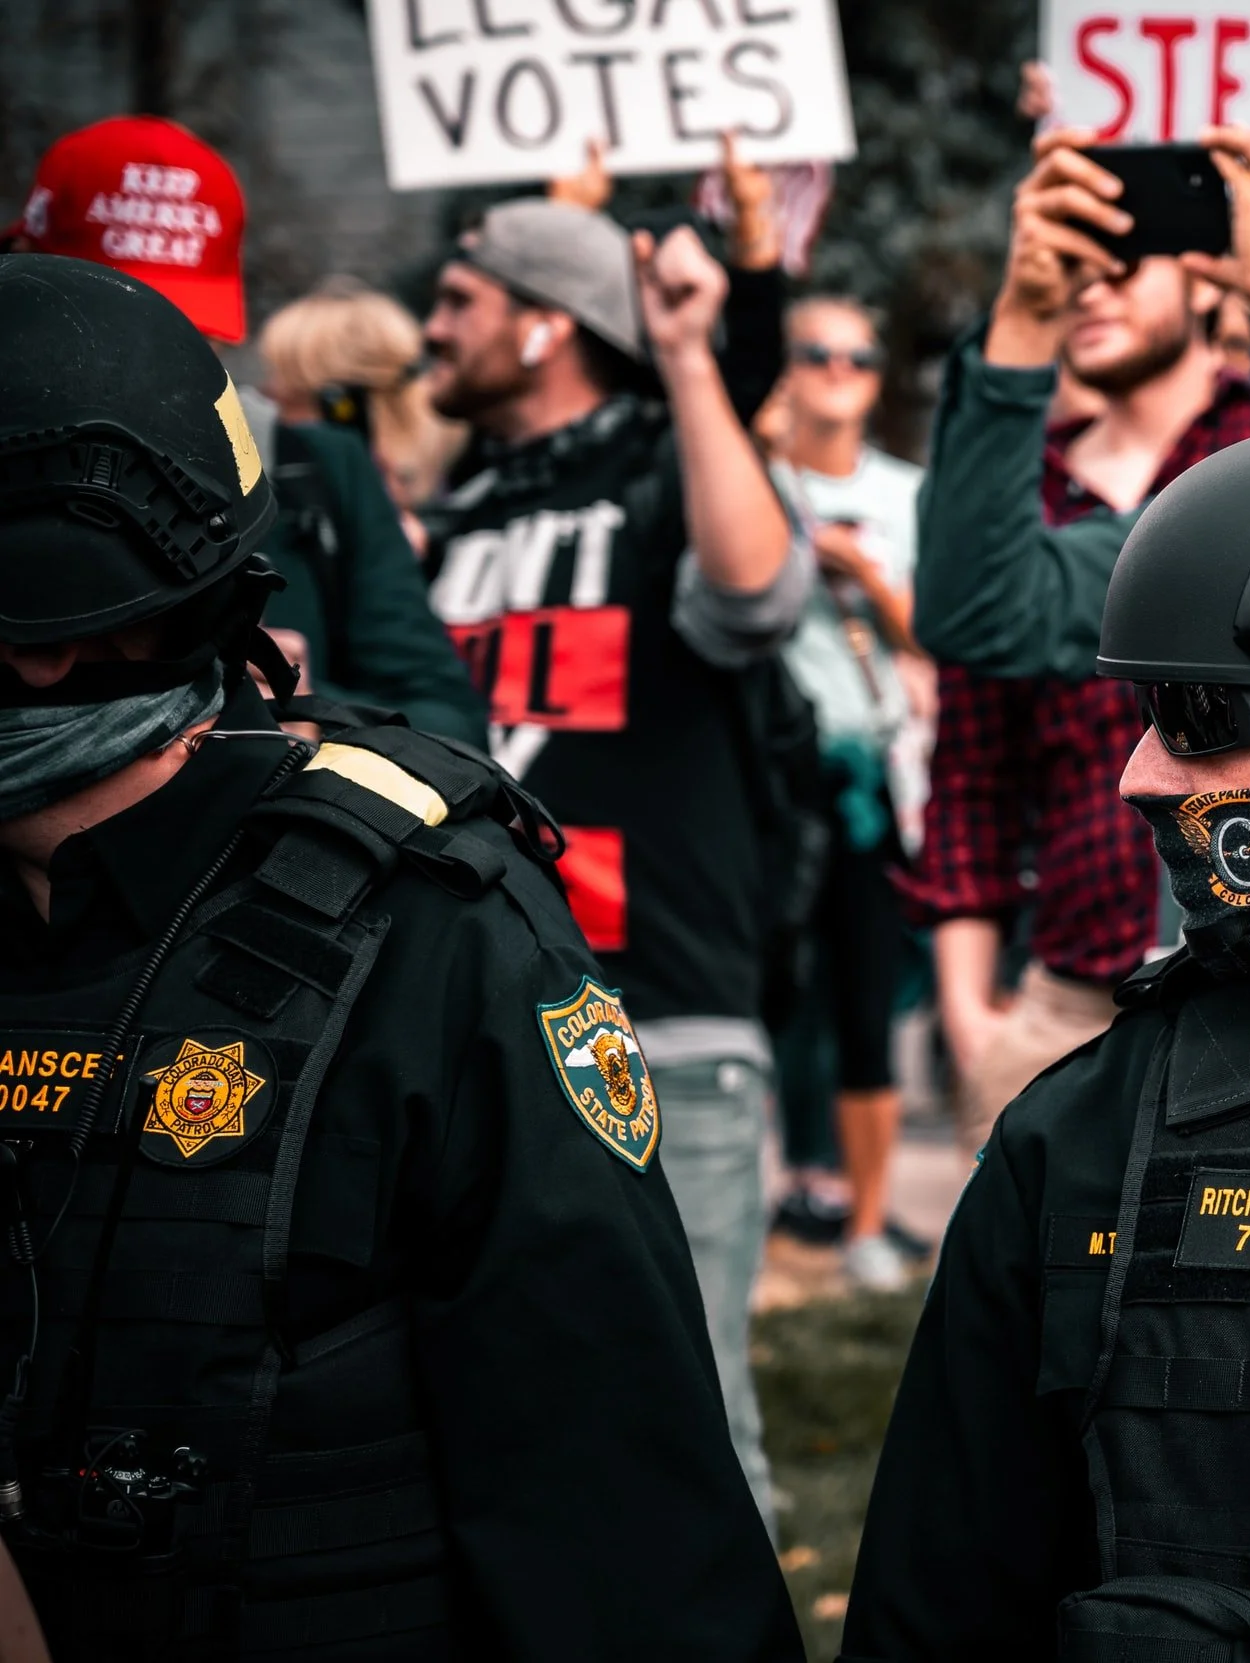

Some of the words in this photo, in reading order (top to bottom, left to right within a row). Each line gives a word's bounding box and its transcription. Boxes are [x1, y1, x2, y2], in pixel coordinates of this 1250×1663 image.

[418, 39, 796, 151] VOTES
[85, 191, 222, 238] AMERICA
[102, 225, 205, 268] GREAT
[1185, 791, 1218, 815] STATE
[163, 1055, 225, 1086] COLORADO
[223, 1061, 244, 1089] STATE
[170, 1119, 220, 1135] PATROL
[579, 1086, 628, 1141] STATE
